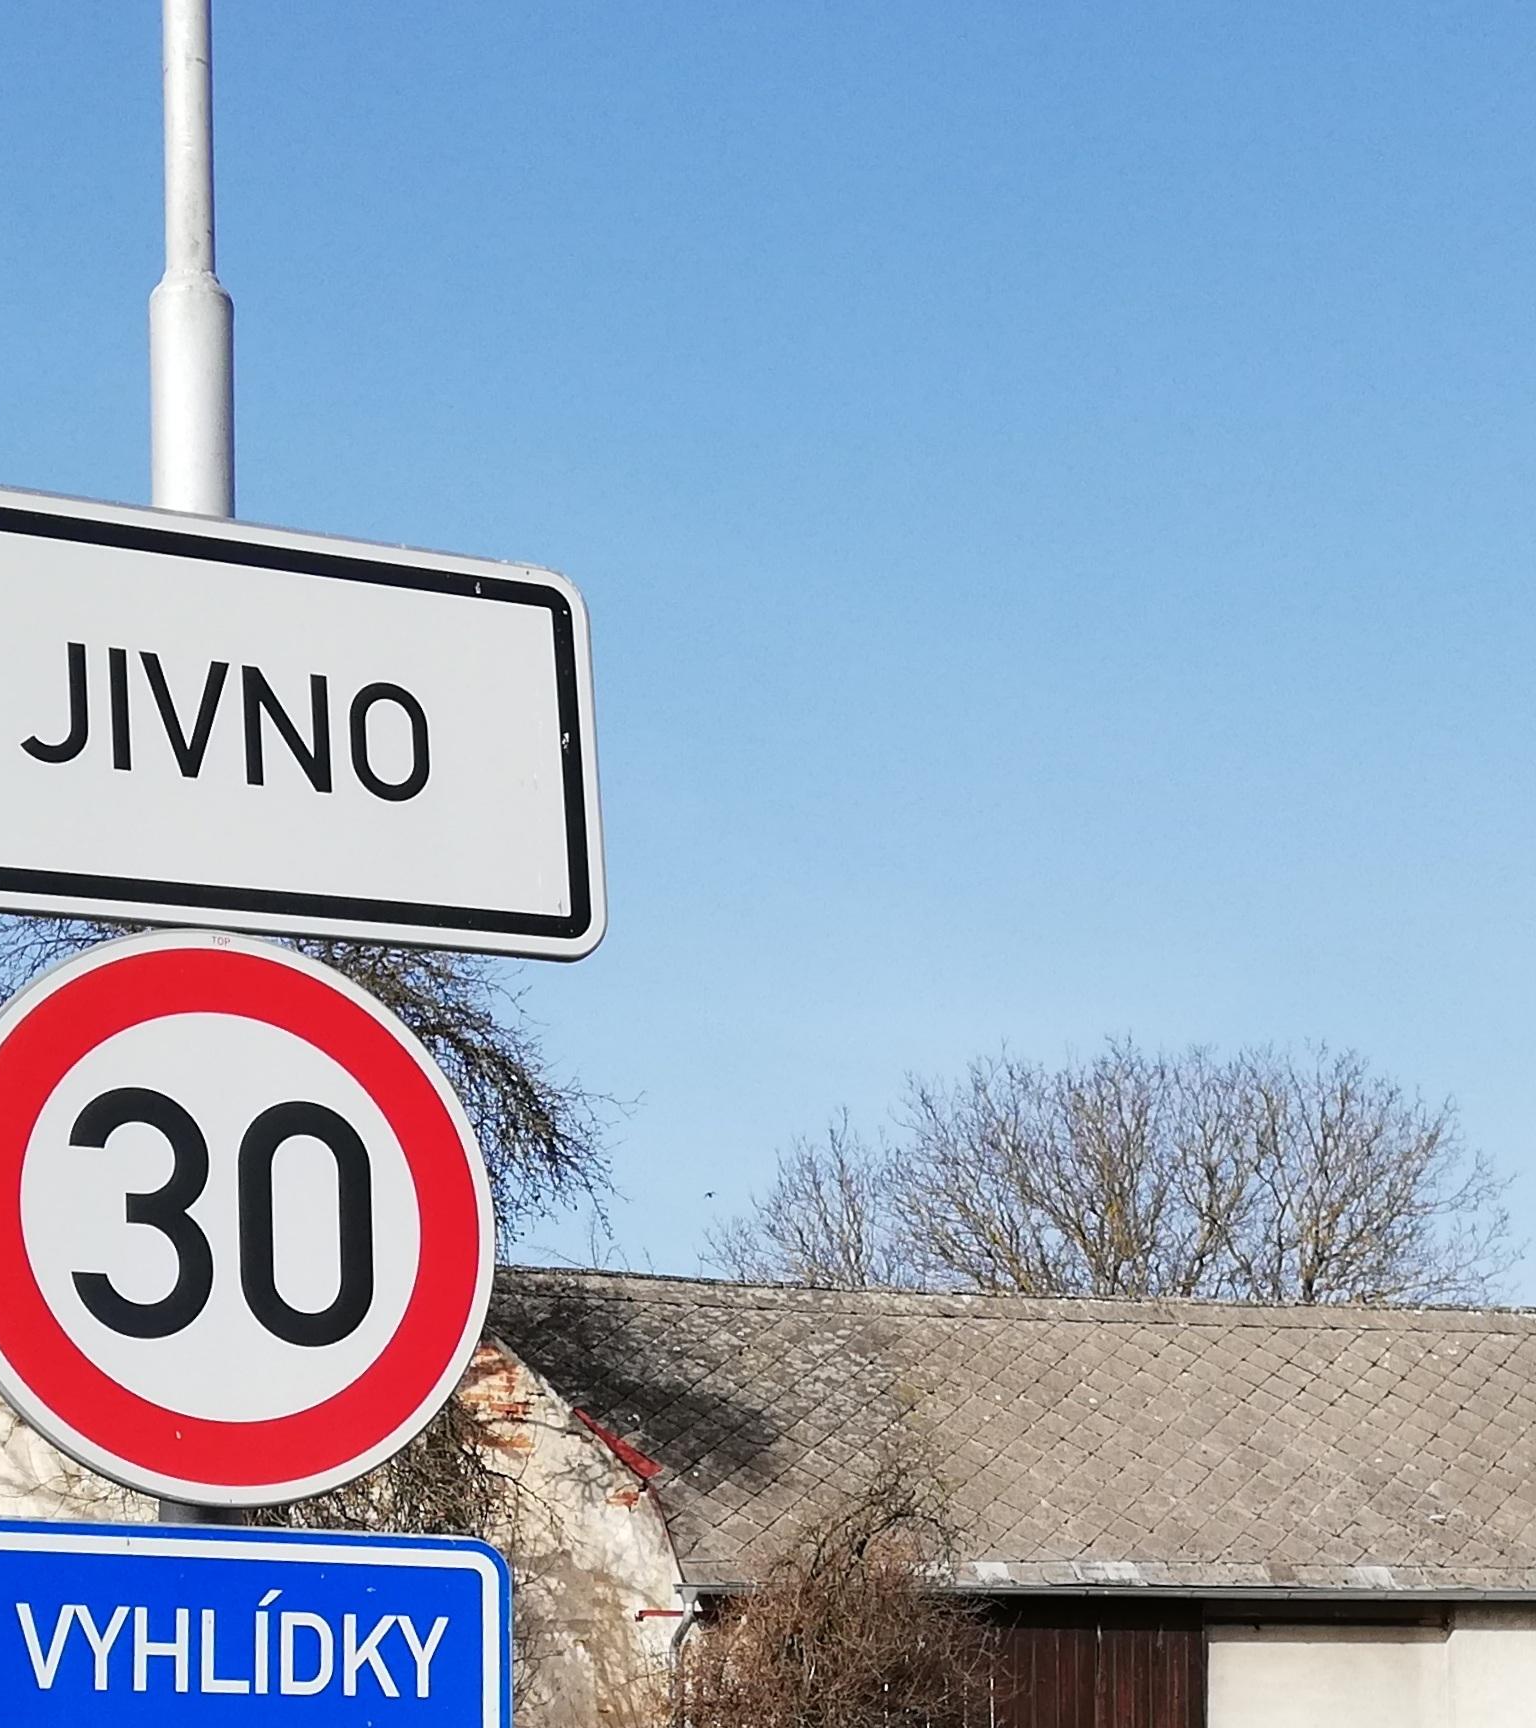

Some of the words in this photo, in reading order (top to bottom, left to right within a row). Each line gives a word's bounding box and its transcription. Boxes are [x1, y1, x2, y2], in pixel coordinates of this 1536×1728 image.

[20, 641, 430, 802] JIVNO
[211, 935, 231, 947] TOP
[68, 1086, 374, 1348] 30
[15, 1589, 449, 1699] VYHLÍDKY
